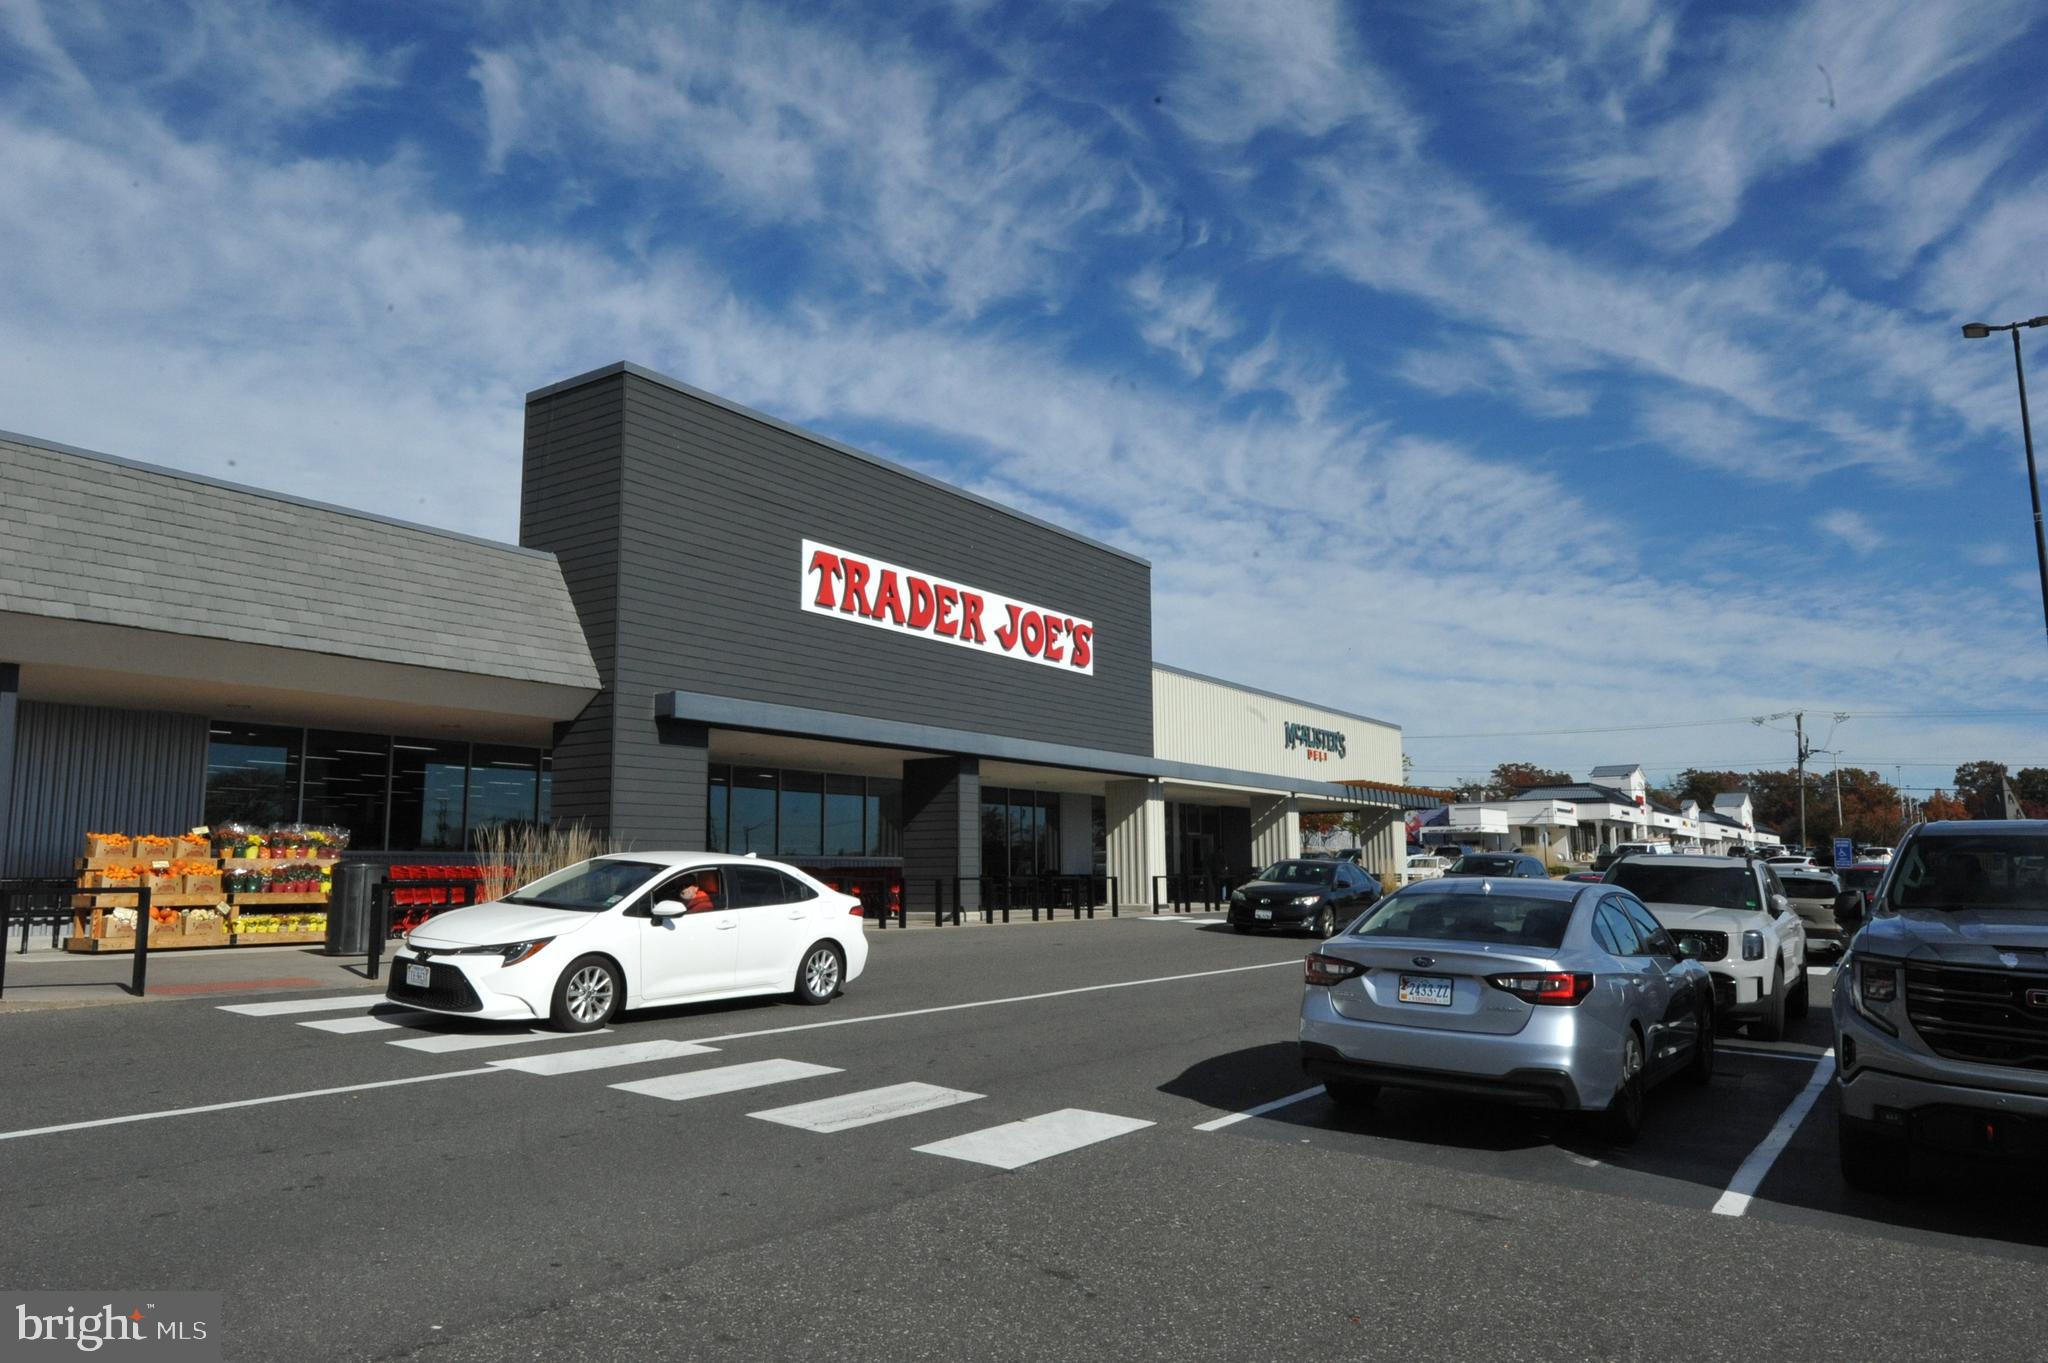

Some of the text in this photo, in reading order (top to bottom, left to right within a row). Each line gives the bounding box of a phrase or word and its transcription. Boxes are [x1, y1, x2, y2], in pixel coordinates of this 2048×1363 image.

[808, 550, 1095, 668] TRADER JOE'S
[1307, 749, 1328, 762] DELI
